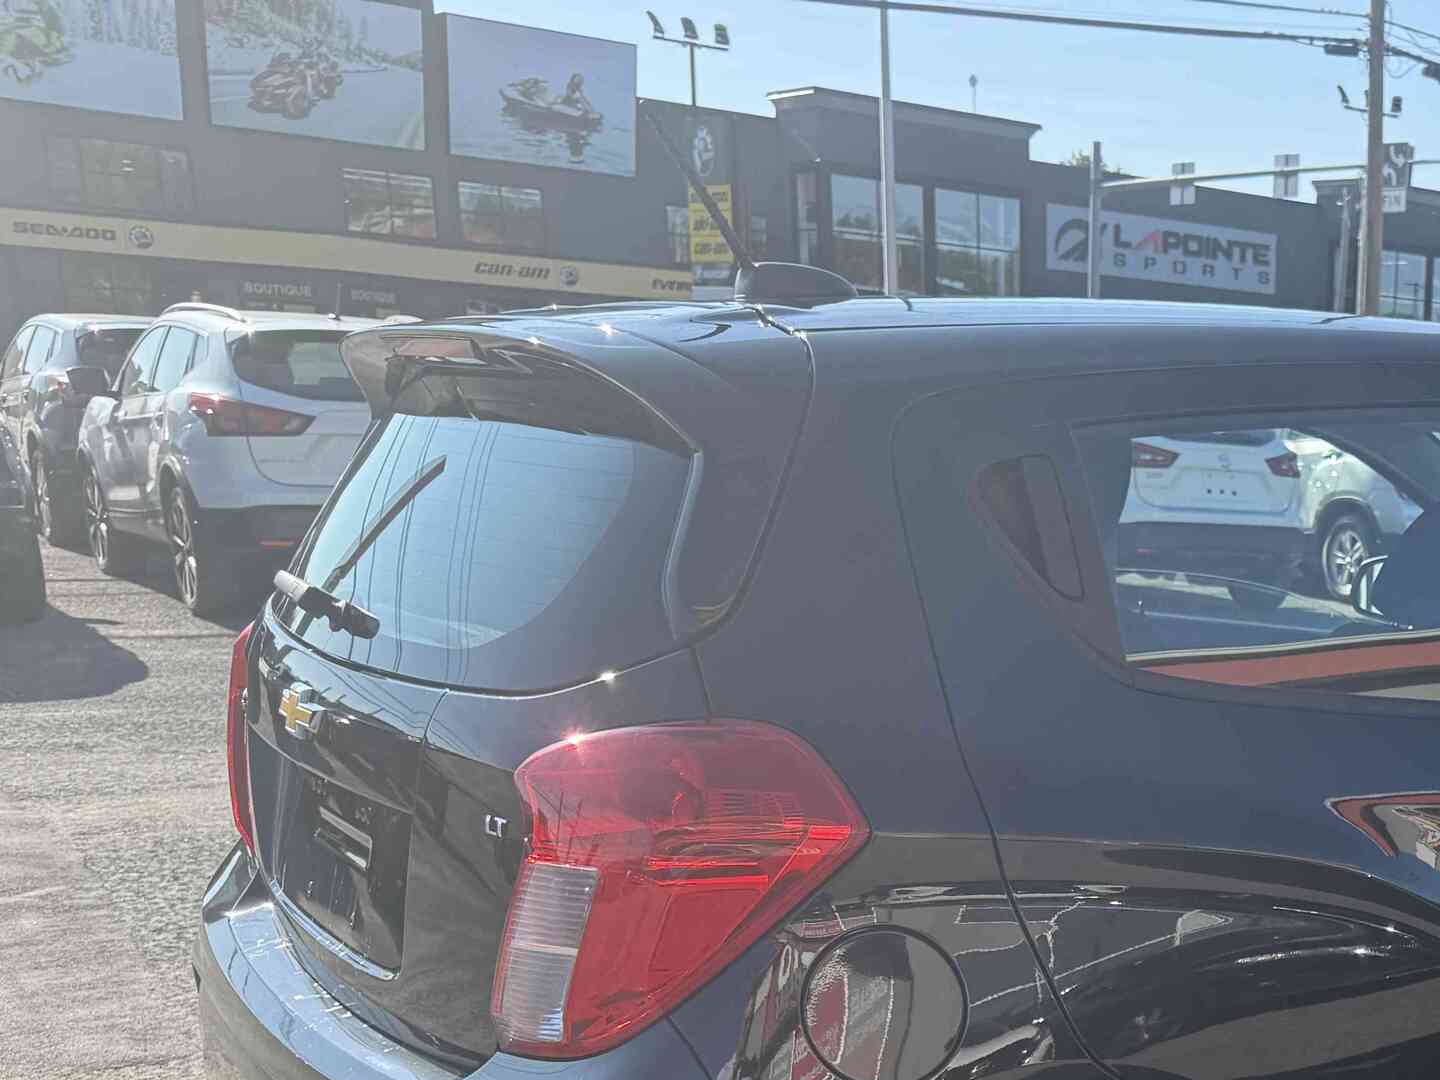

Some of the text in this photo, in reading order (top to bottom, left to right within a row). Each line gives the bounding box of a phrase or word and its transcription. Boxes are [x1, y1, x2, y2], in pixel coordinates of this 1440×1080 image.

[1112, 223, 1272, 267] LAPOINTE
[1113, 253, 1271, 285] SPORTS
[485, 814, 507, 838] LT
